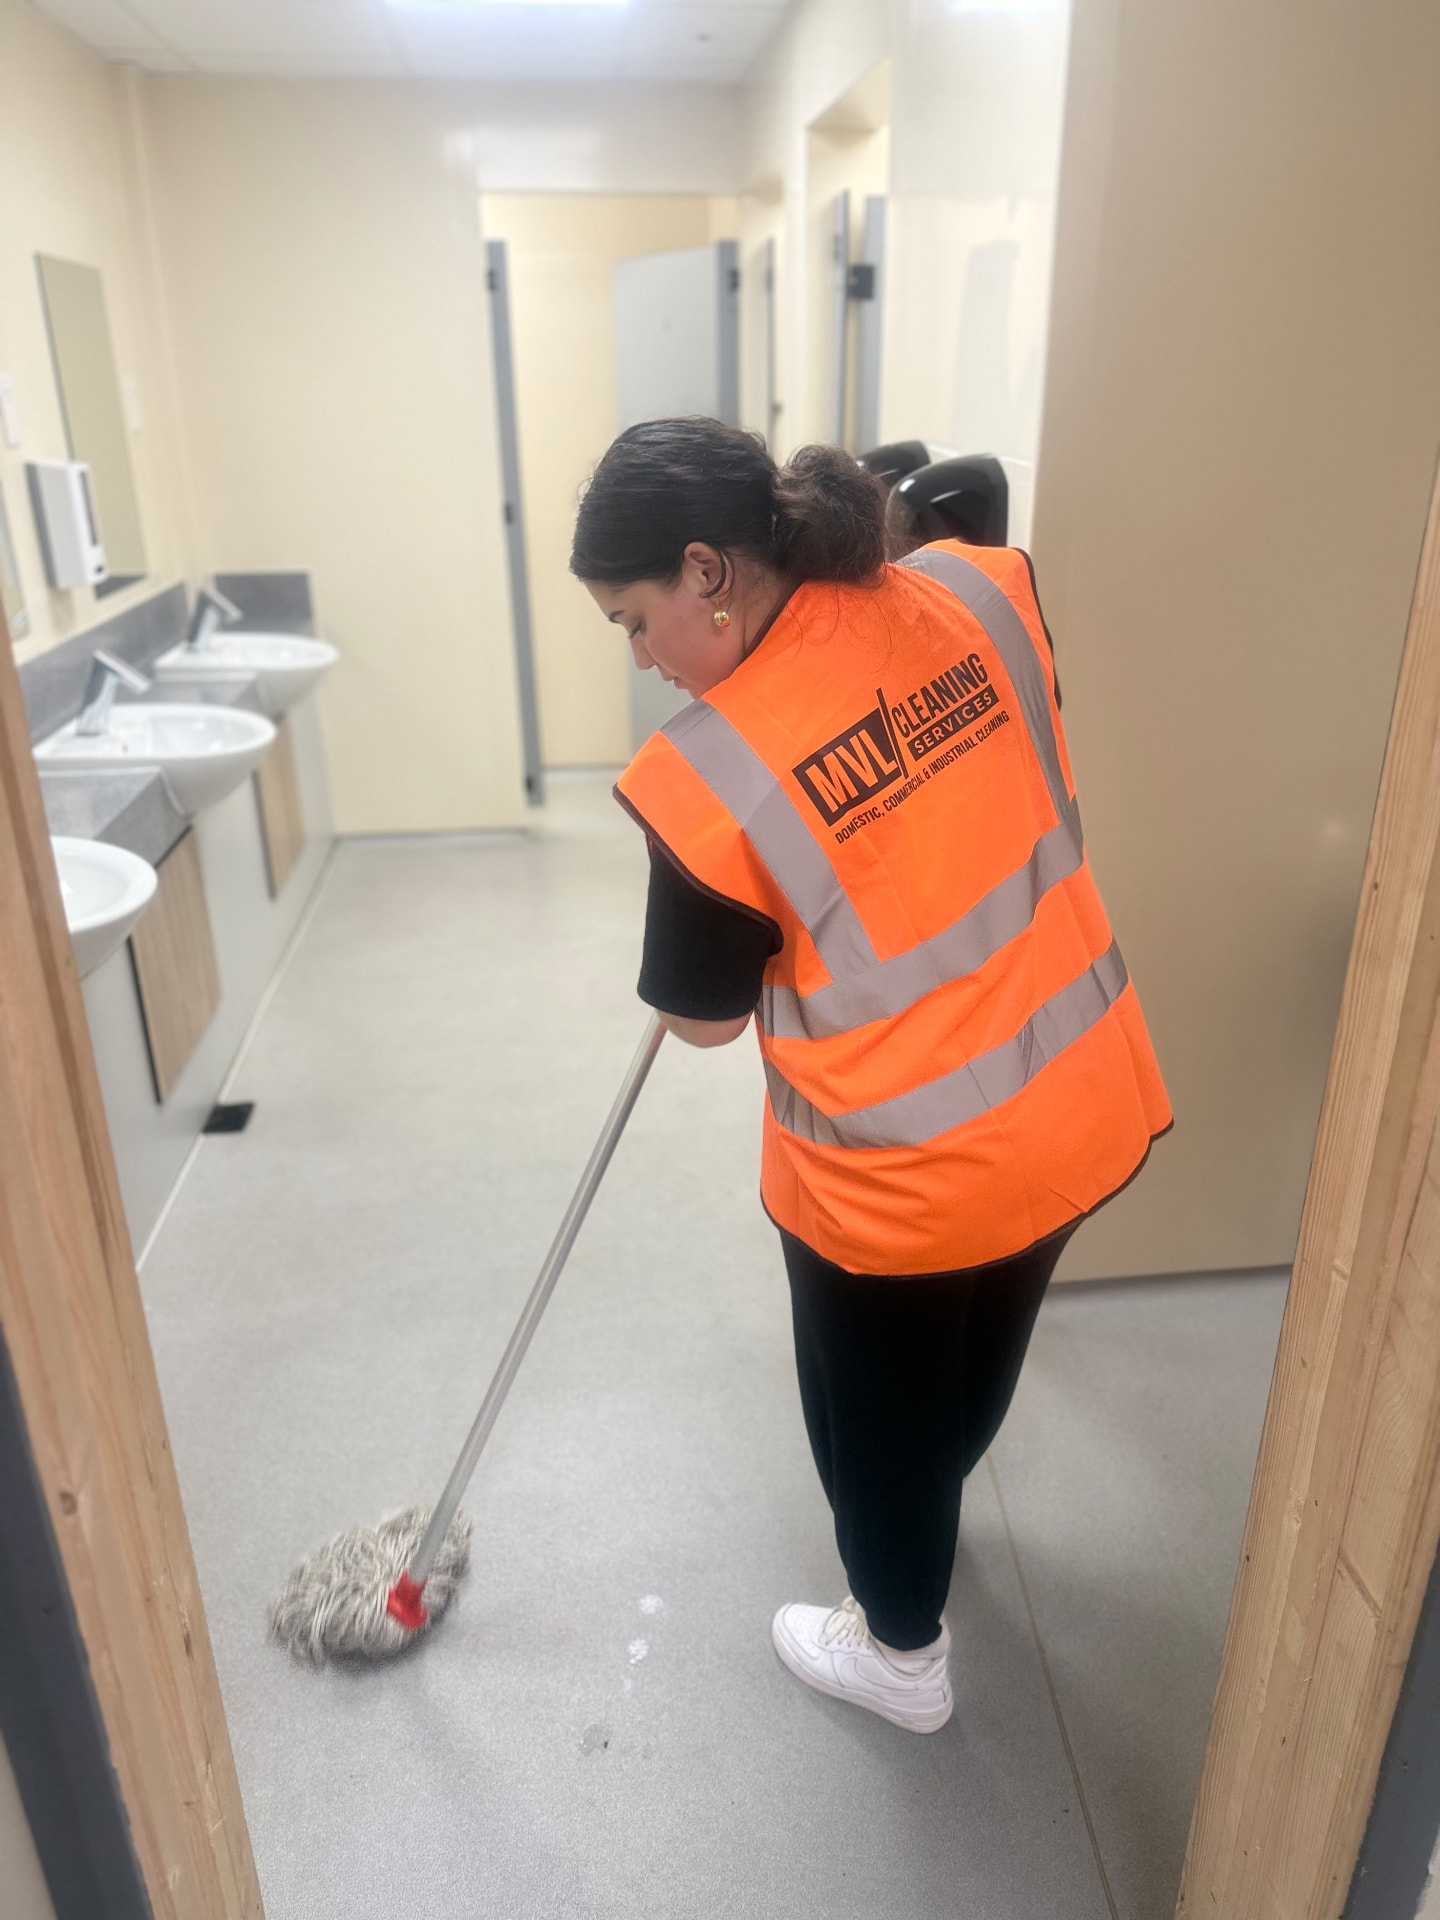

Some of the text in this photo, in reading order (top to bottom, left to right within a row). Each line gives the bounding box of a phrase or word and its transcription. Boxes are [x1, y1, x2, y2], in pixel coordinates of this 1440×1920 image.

[891, 653, 988, 738] CLEANING
[914, 691, 992, 754] SERVICES
[805, 729, 898, 814] MVL
[834, 710, 1010, 844] DOMESTIC, COMMERCIAL & INDUSTRIAL CLEANING
